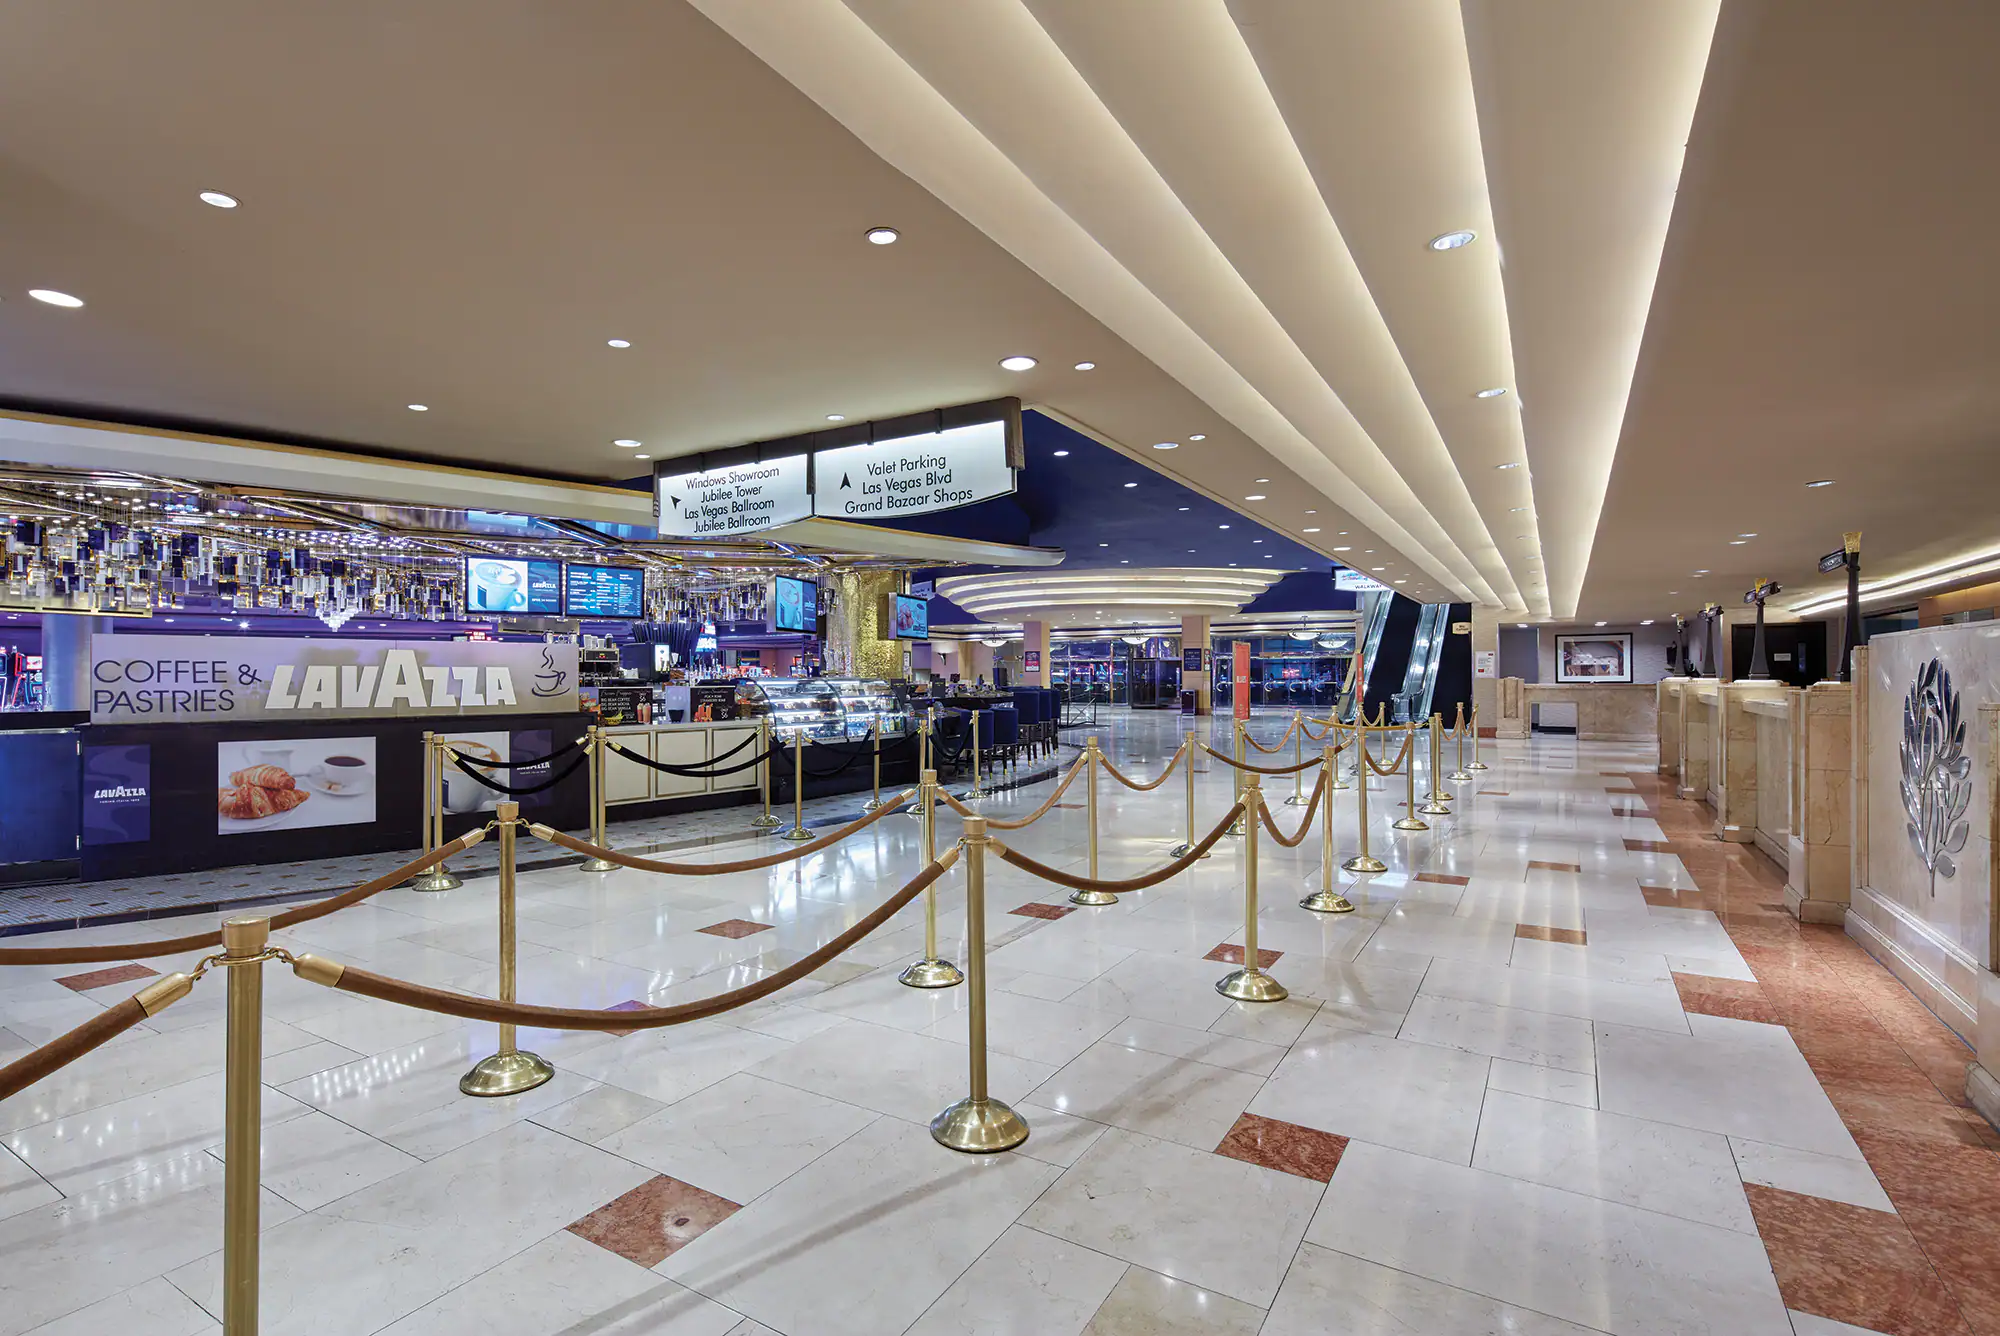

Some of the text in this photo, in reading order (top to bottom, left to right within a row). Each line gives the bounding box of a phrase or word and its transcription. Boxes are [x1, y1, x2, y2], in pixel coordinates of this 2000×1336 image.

[867, 454, 946, 477] Valet Parking
[685, 467, 780, 490] Windows Showroom
[862, 469, 952, 495] Las Vegas Blvd
[701, 484, 763, 503] Jubilee Tower
[844, 487, 973, 514] Grand Bazaar Shops
[684, 499, 775, 520] Las Vegas Ballroom
[693, 514, 771, 533] Jubilee Ballroom
[93, 659, 263, 686] COFFEE &
[264, 649, 518, 709] LAVAZZA
[93, 689, 235, 714] PASTRIES
[94, 786, 146, 798] LAVAZZA
